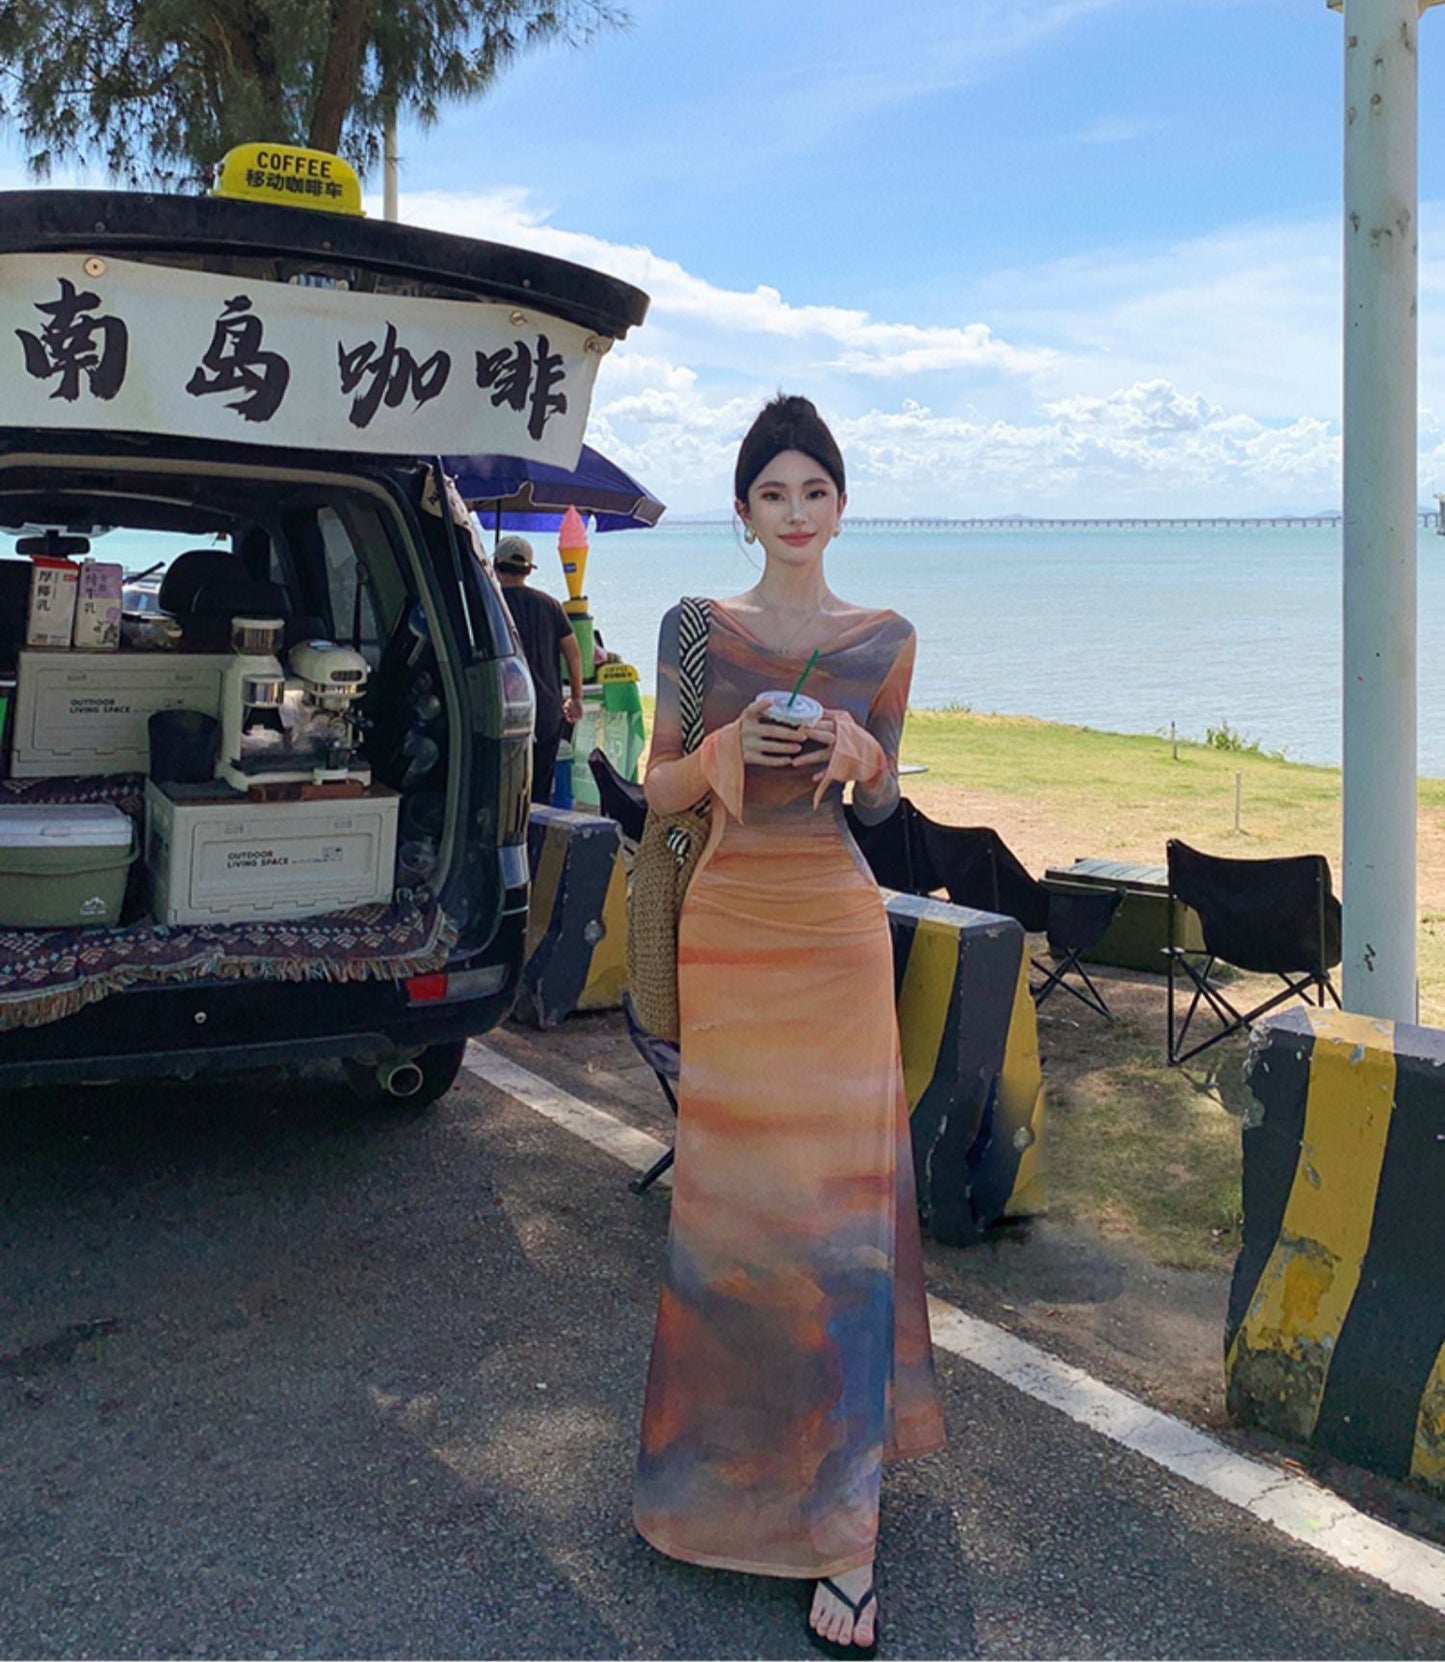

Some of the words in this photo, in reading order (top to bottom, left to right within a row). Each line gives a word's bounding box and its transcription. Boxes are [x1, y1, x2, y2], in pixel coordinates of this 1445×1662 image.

[257, 151, 332, 179] COFFEE
[245, 169, 344, 199] 移动咖啡车
[15, 277, 570, 441] 南岛咖啡
[69, 706, 100, 714] LIVING
[227, 850, 274, 860] OUTDOOR
[227, 860, 257, 869] LIVING
[261, 857, 289, 867] SPACE
